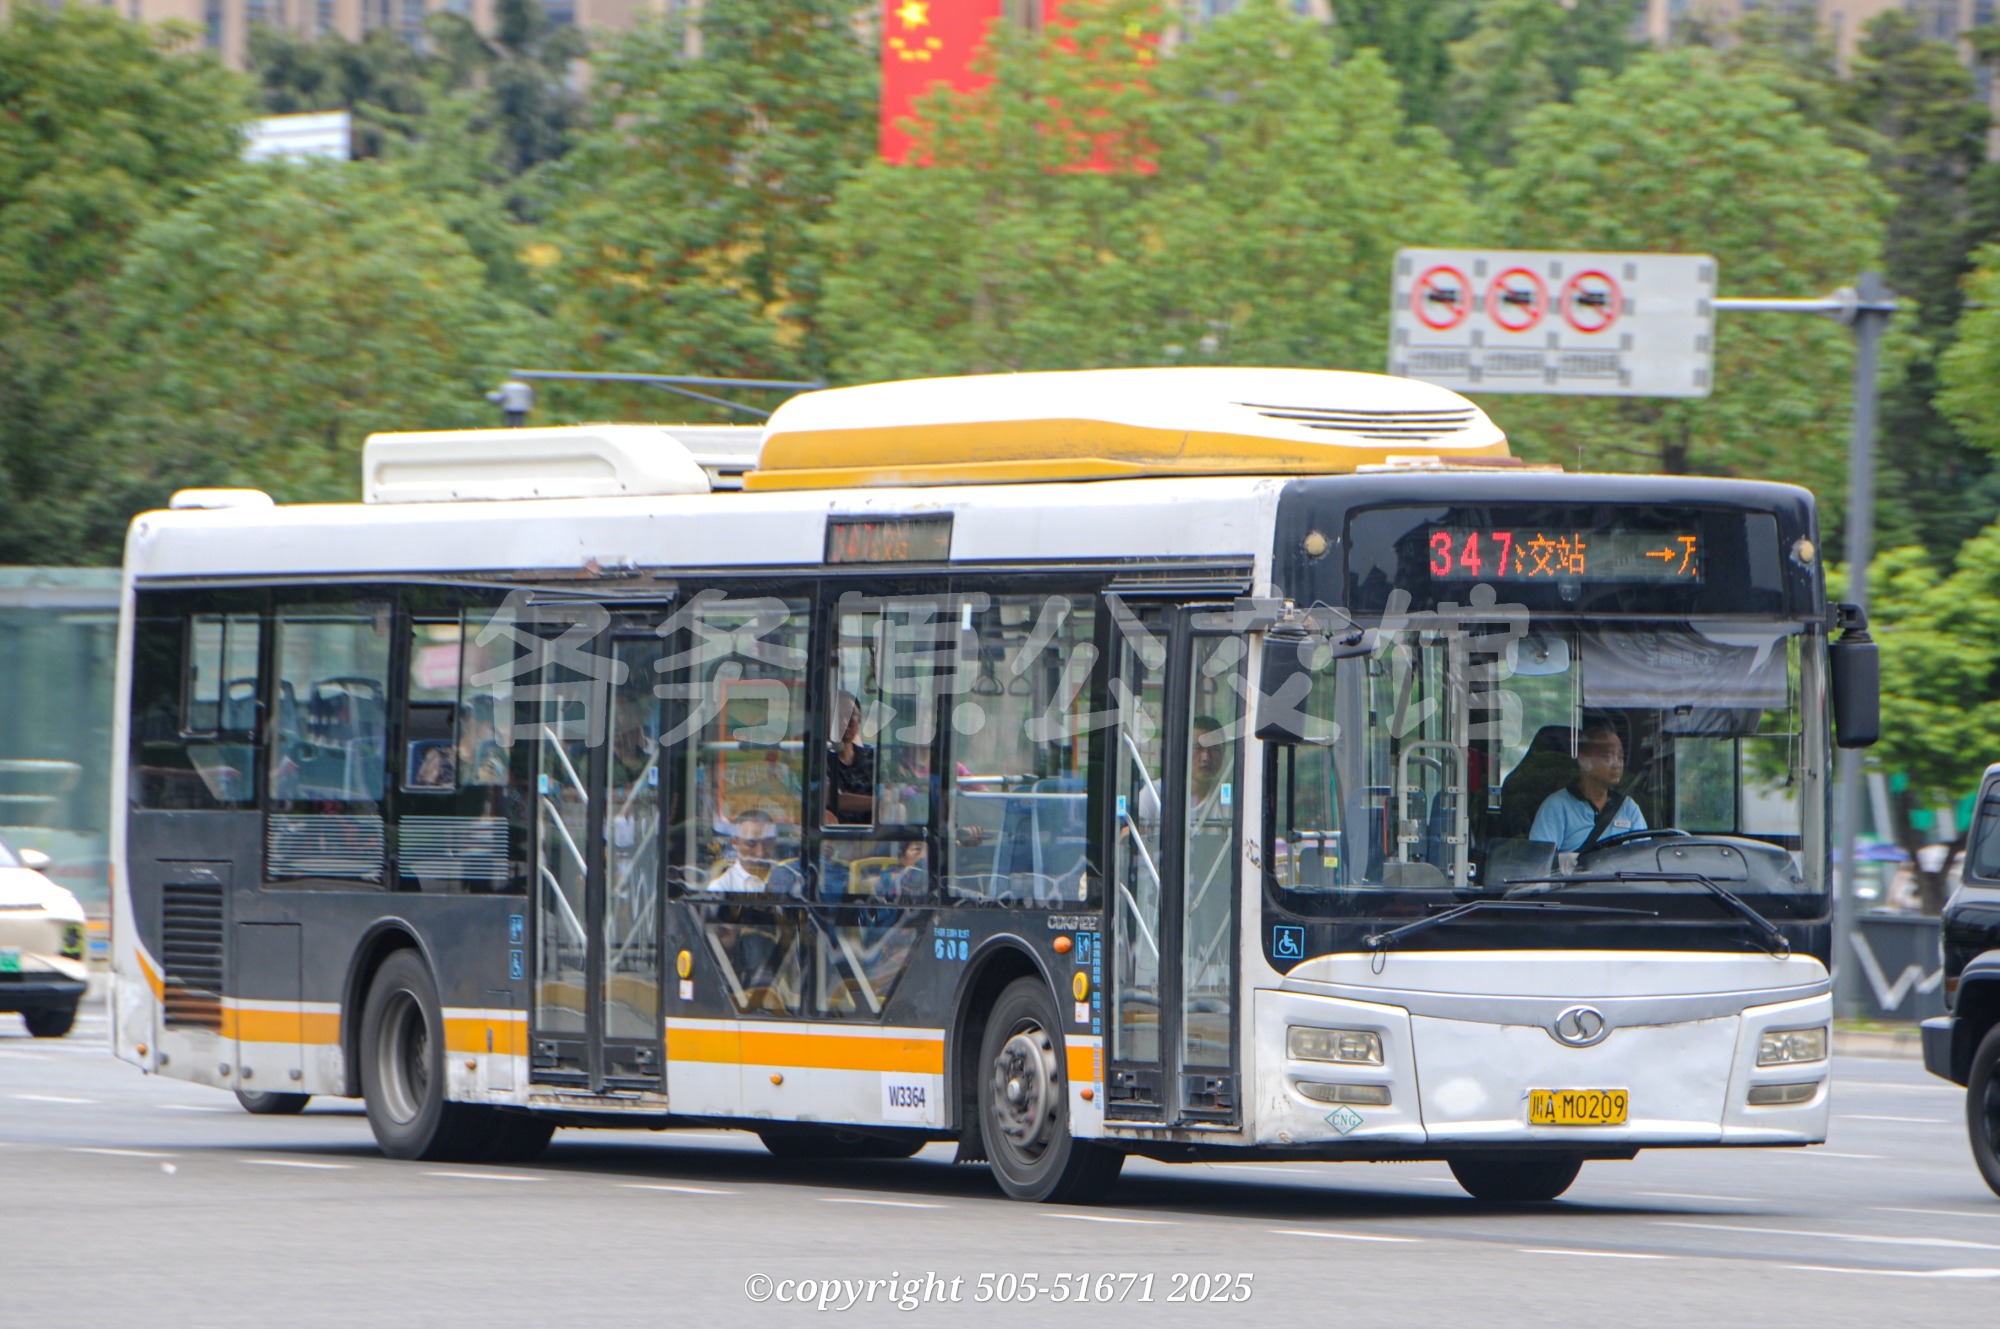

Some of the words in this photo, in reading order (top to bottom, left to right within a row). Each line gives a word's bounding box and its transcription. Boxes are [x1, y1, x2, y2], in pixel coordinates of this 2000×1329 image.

[1430, 531, 1513, 577] 347
[888, 1085, 926, 1108] W3364
[1332, 1114, 1356, 1126] CNG
